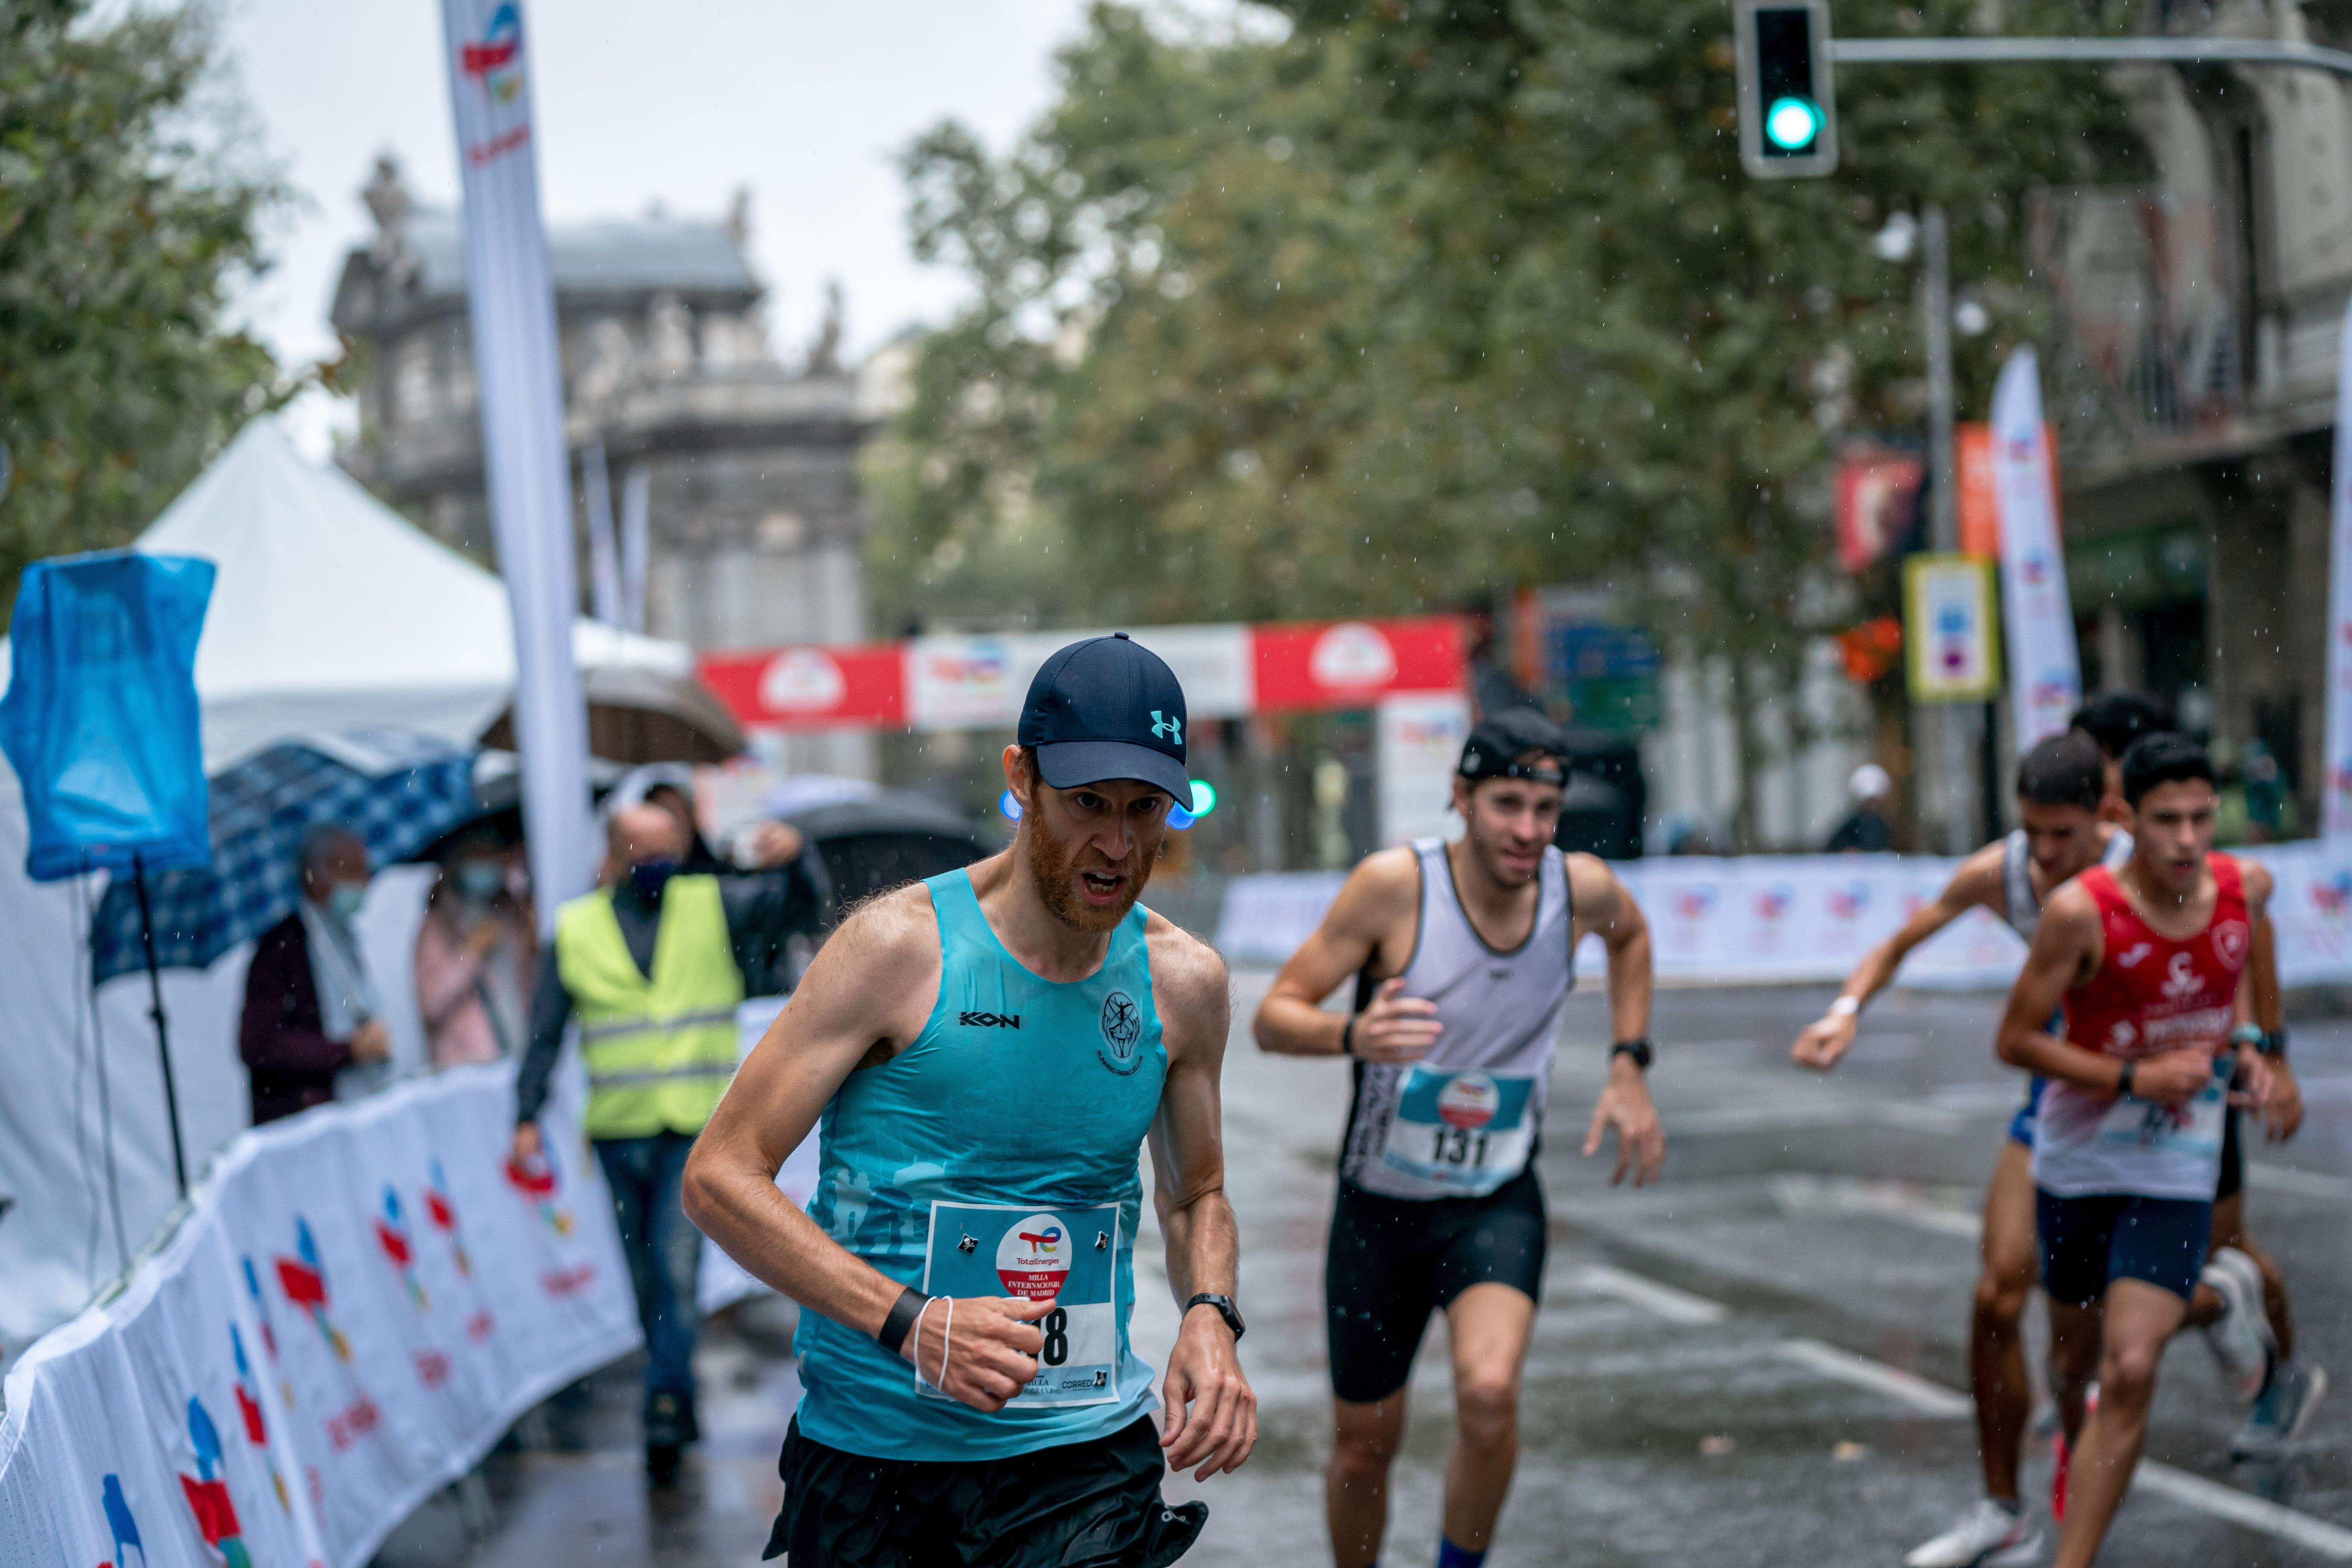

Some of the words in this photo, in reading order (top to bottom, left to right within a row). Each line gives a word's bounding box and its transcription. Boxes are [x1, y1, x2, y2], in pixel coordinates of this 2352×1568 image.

[1434, 1129, 1487, 1167] 131
[1017, 1258, 1059, 1266] TotalEnergies
[1062, 1379, 1096, 1388] CORRED
